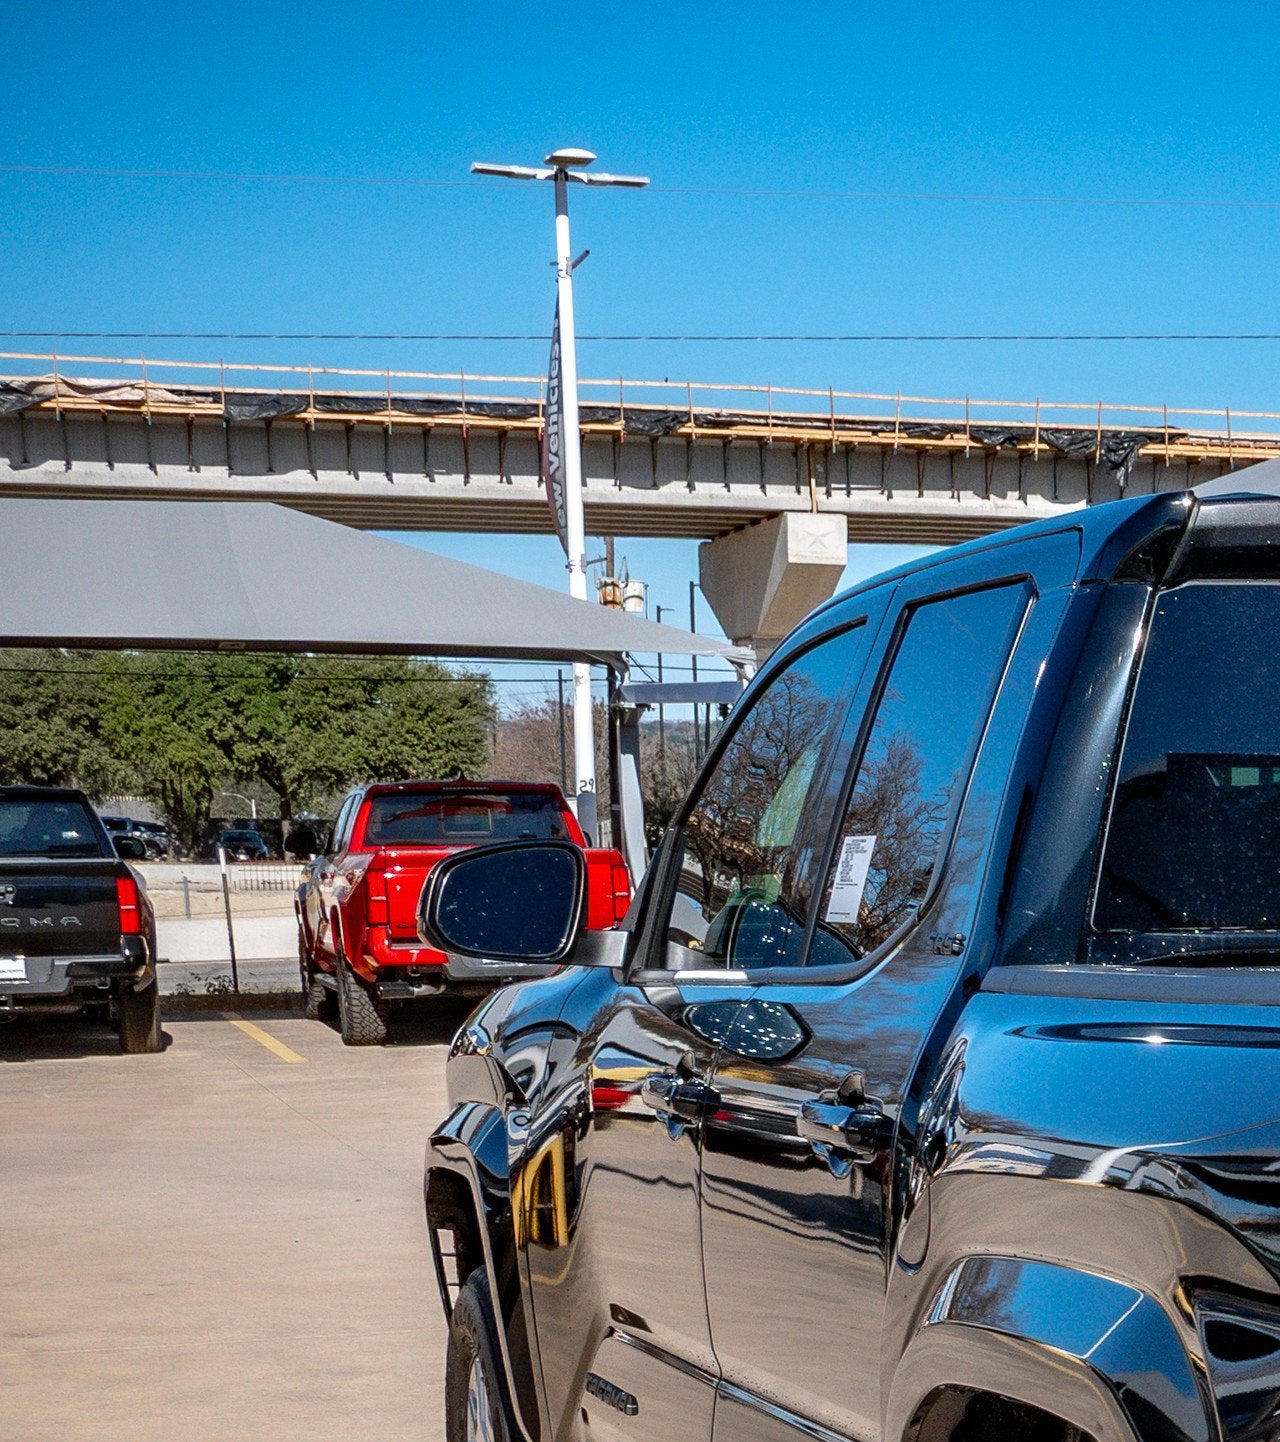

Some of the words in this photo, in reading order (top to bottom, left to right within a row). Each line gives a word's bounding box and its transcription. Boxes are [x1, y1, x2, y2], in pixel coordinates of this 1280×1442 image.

[547, 342, 560, 475] Vehicles
[552, 481, 567, 528] ew
[579, 778, 595, 793] 29
